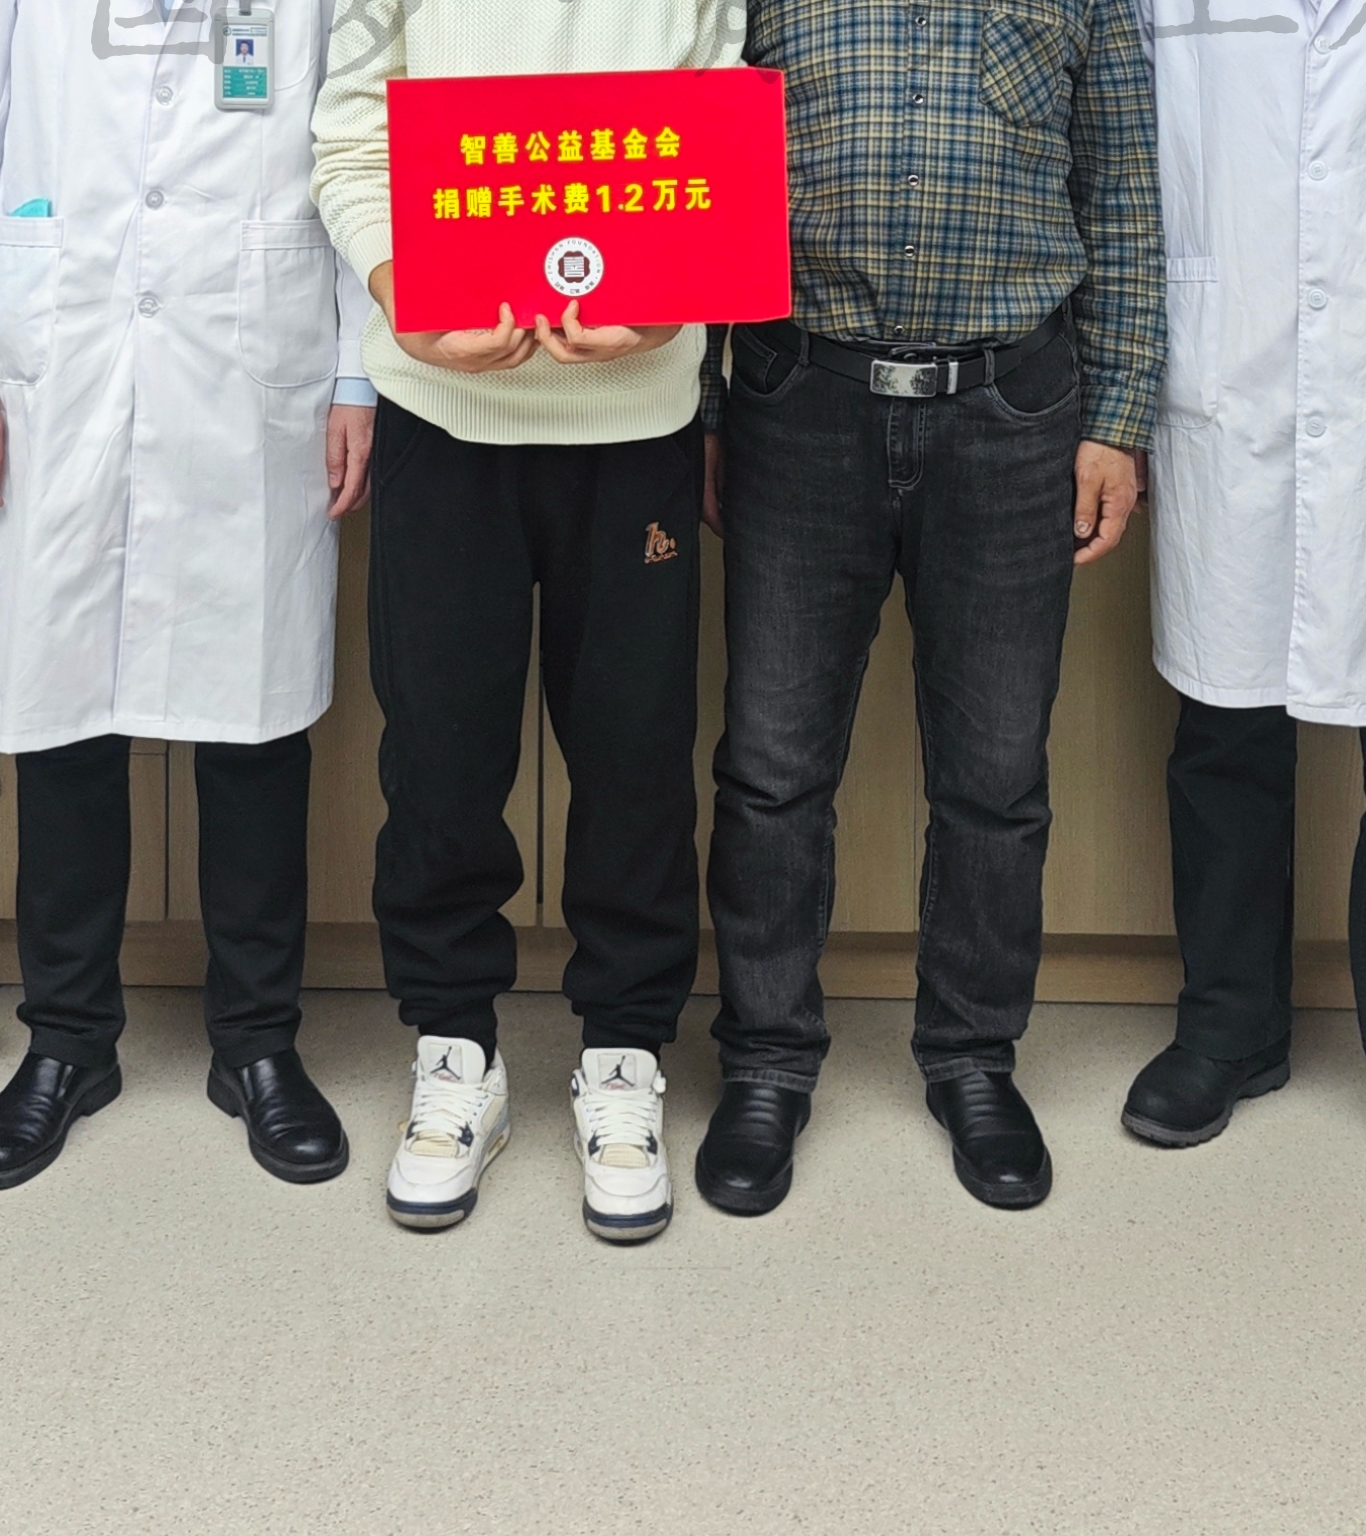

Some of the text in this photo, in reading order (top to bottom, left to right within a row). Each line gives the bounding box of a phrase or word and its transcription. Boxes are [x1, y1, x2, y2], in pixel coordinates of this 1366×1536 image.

[460, 127, 681, 166] 智善公益基金会
[433, 178, 712, 219] 捐赠手术费1.2万元
